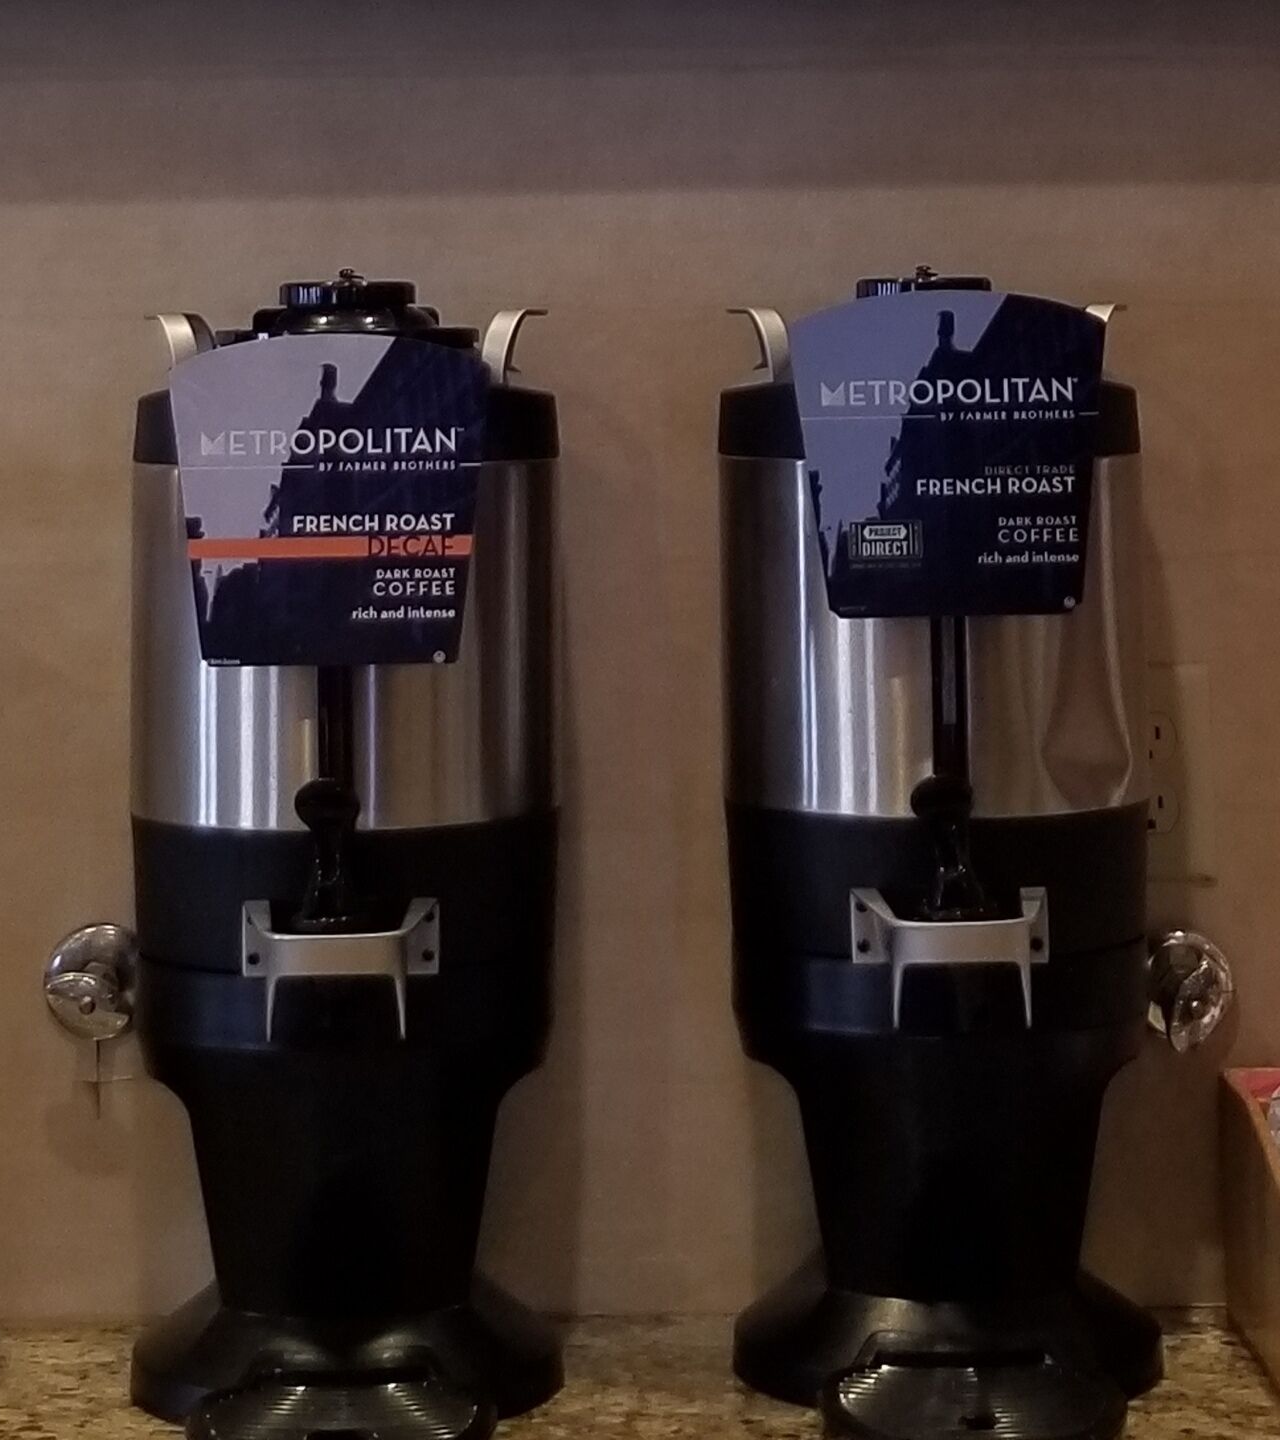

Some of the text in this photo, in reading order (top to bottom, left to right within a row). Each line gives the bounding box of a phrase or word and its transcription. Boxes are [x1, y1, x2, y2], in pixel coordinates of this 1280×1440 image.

[821, 377, 1074, 407] METROPOLITAN
[940, 410, 1076, 421] BY FARMER BROTHERS
[200, 428, 457, 456] METROPOLITAN
[318, 460, 457, 472] BY FARMER BROTHERS
[984, 464, 1076, 475] DIRECT TRADE
[916, 476, 1076, 496] FRENCH ROAST
[292, 513, 456, 533] FRENCH ROAST
[998, 515, 1077, 527] DARK ROAST
[997, 528, 1080, 544] COFFEE
[368, 535, 455, 557] DECAF
[862, 541, 908, 556] DIRECT
[978, 551, 1080, 564] rich and intense
[376, 567, 456, 579] DARK ROAST
[372, 581, 456, 597] COFFEE
[351, 607, 456, 620] rich and intense
